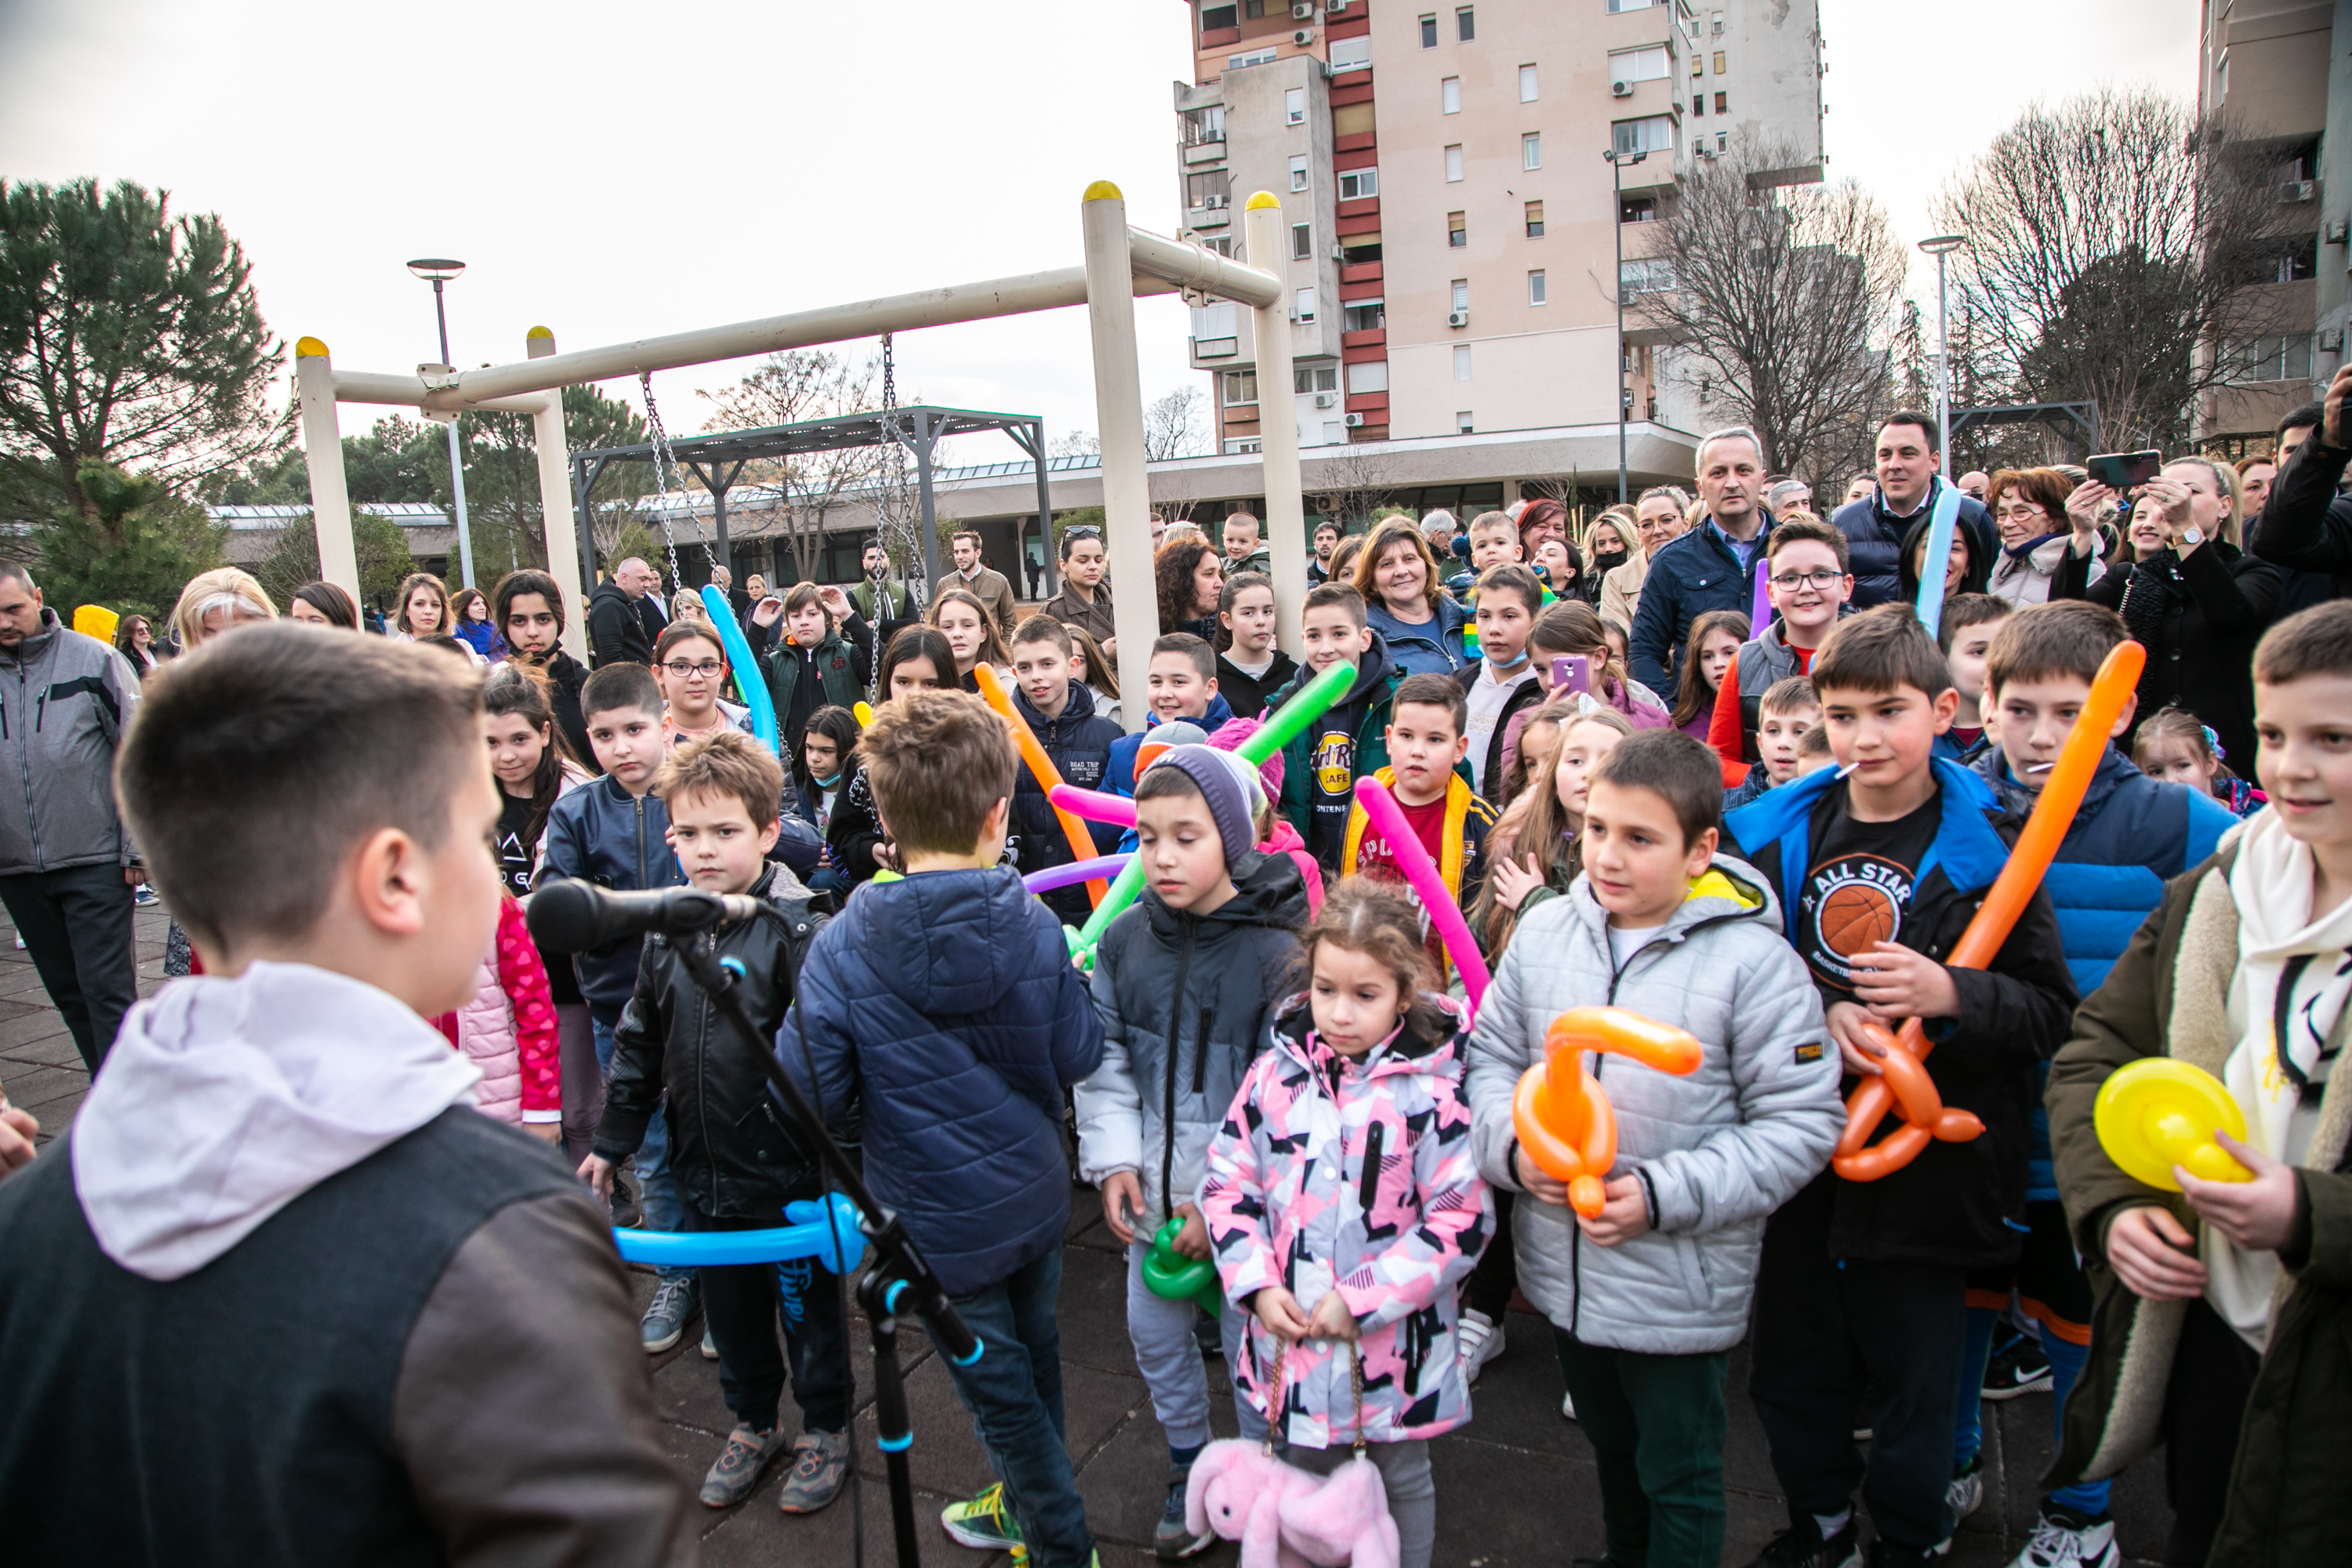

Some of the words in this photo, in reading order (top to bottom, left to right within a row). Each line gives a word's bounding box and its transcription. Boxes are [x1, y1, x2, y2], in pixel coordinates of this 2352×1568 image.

[1316, 804, 1347, 813] ONTENE
[1814, 863, 1855, 894] ALL
[1860, 863, 1911, 904] STAR
[1812, 950, 1860, 978] BASKETB
